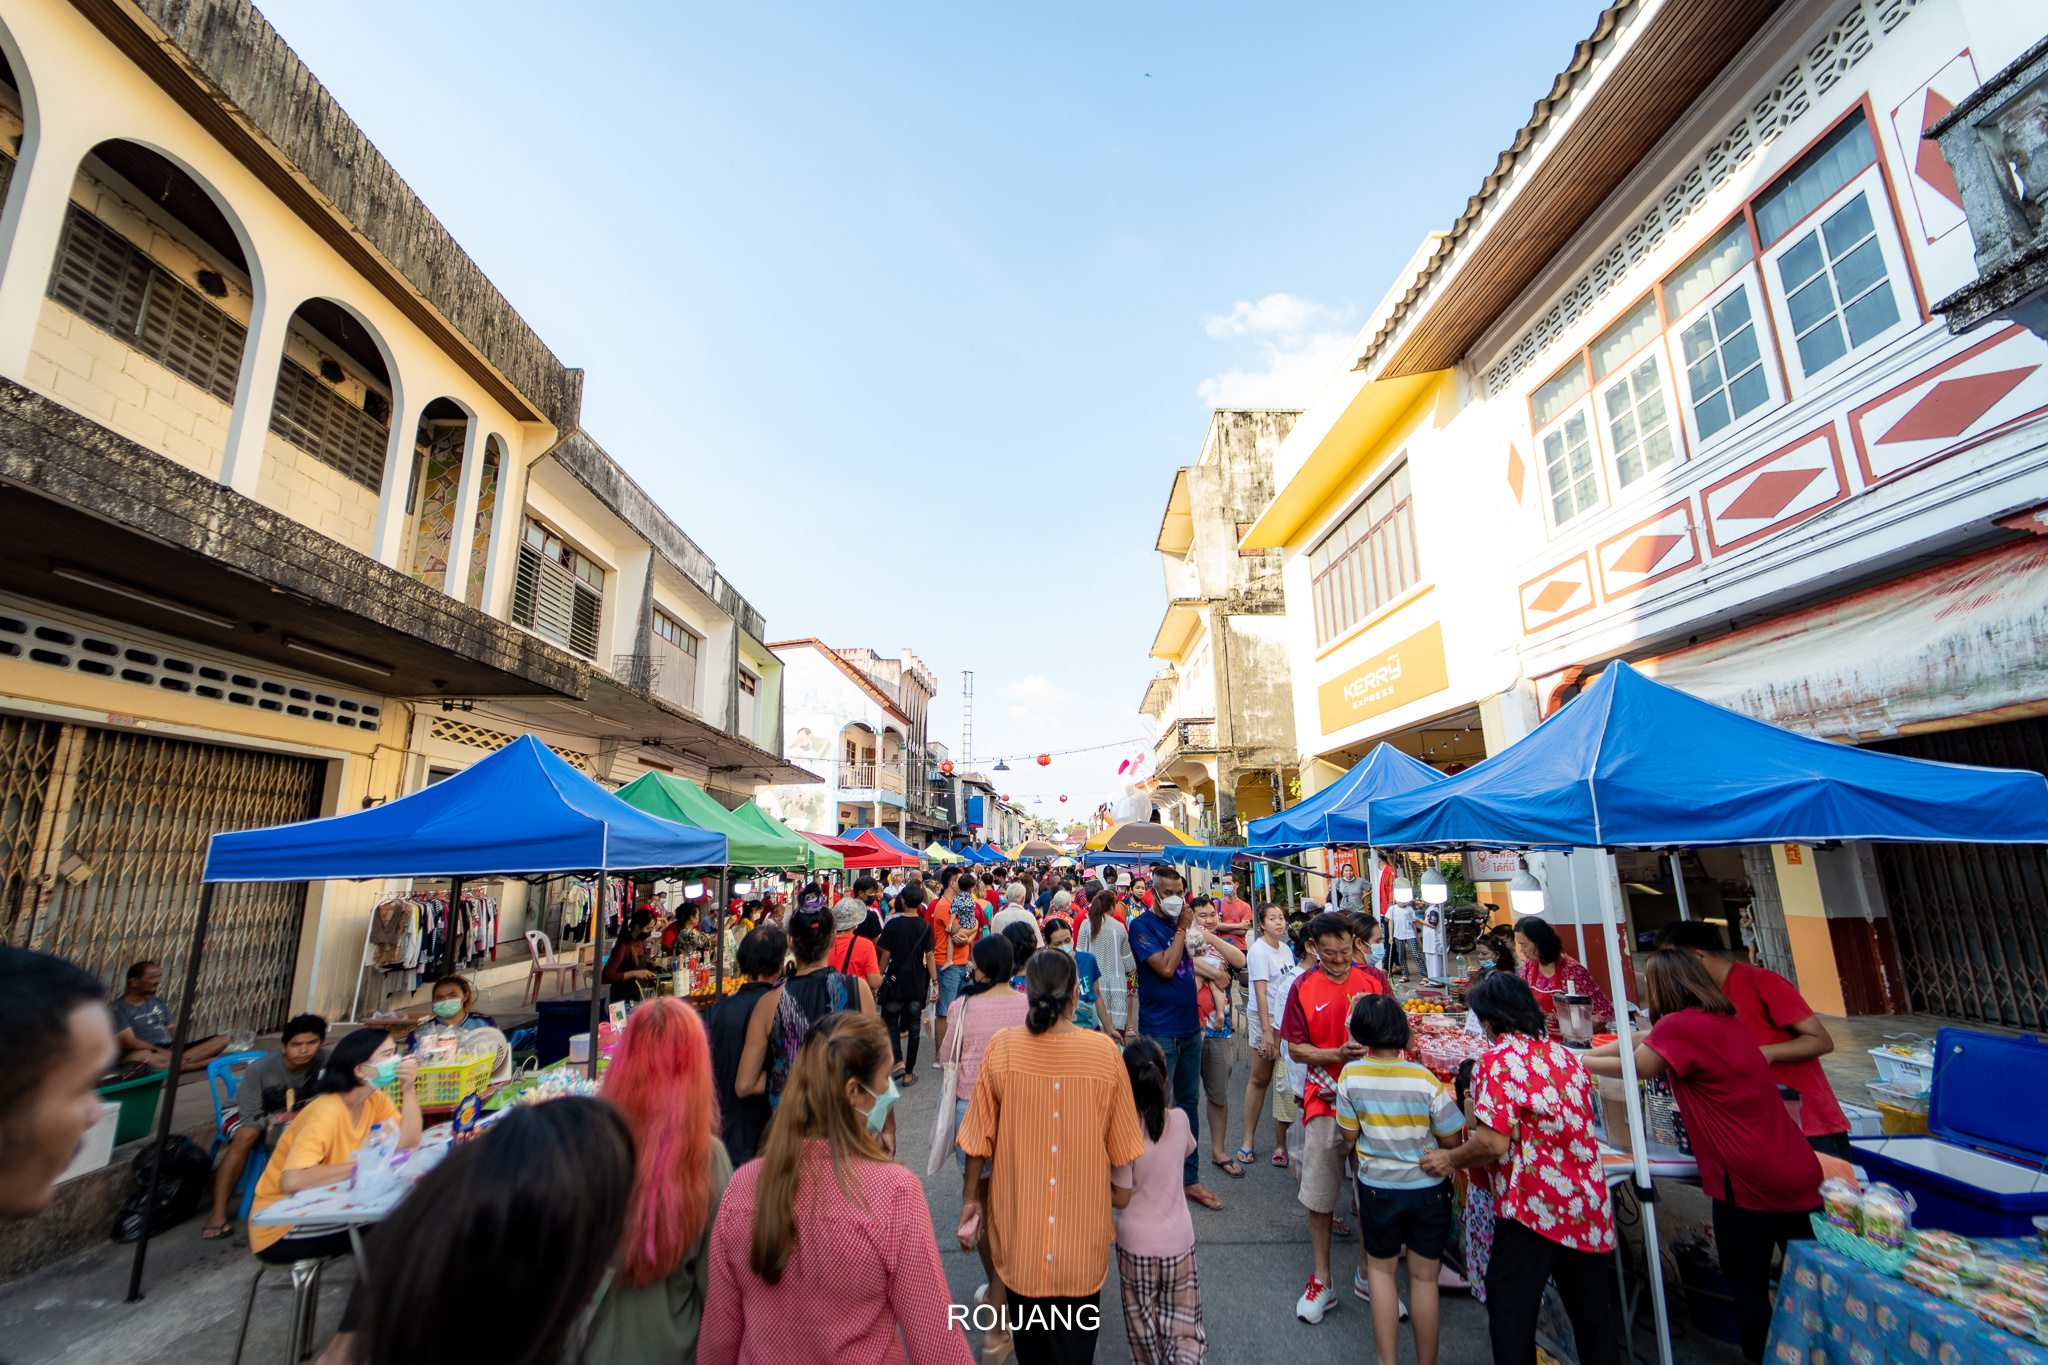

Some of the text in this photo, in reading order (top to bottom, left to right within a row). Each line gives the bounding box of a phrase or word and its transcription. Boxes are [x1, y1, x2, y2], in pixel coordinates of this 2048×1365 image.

[1343, 653, 1402, 702] KERRY
[1352, 685, 1395, 710] EXPRESS
[111, 714, 132, 726] 123
